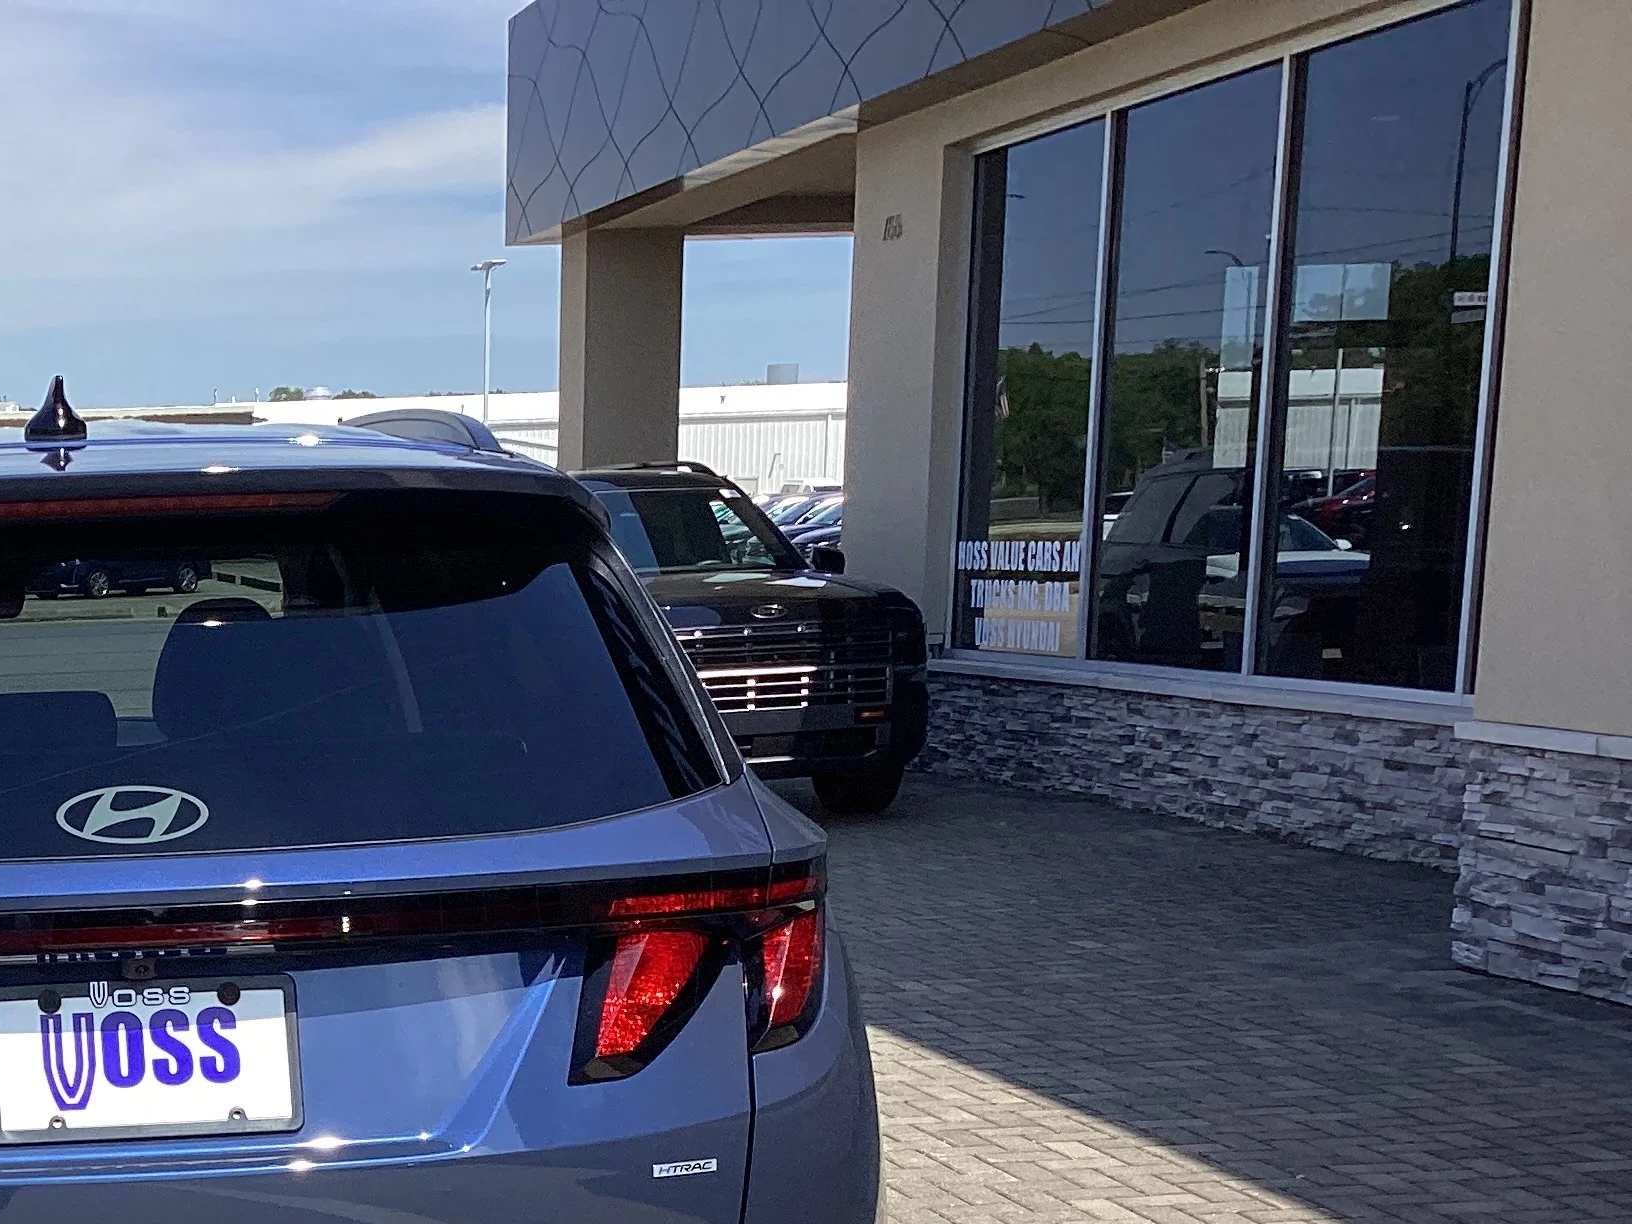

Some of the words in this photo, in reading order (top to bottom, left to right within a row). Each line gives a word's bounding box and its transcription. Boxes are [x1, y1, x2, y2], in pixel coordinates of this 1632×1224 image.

[958, 540, 988, 571] HOSS
[990, 540, 1026, 572] VALUE
[1028, 540, 1060, 572] CARS
[1062, 540, 1081, 573] AN
[970, 578, 1015, 609] TRUCKS
[1044, 581, 1070, 612] DBA
[974, 616, 1005, 648] VOSS
[1006, 619, 1060, 652] HYUNDAI
[40, 1006, 241, 1111] VOSS
[658, 1161, 713, 1176] HTRAC
